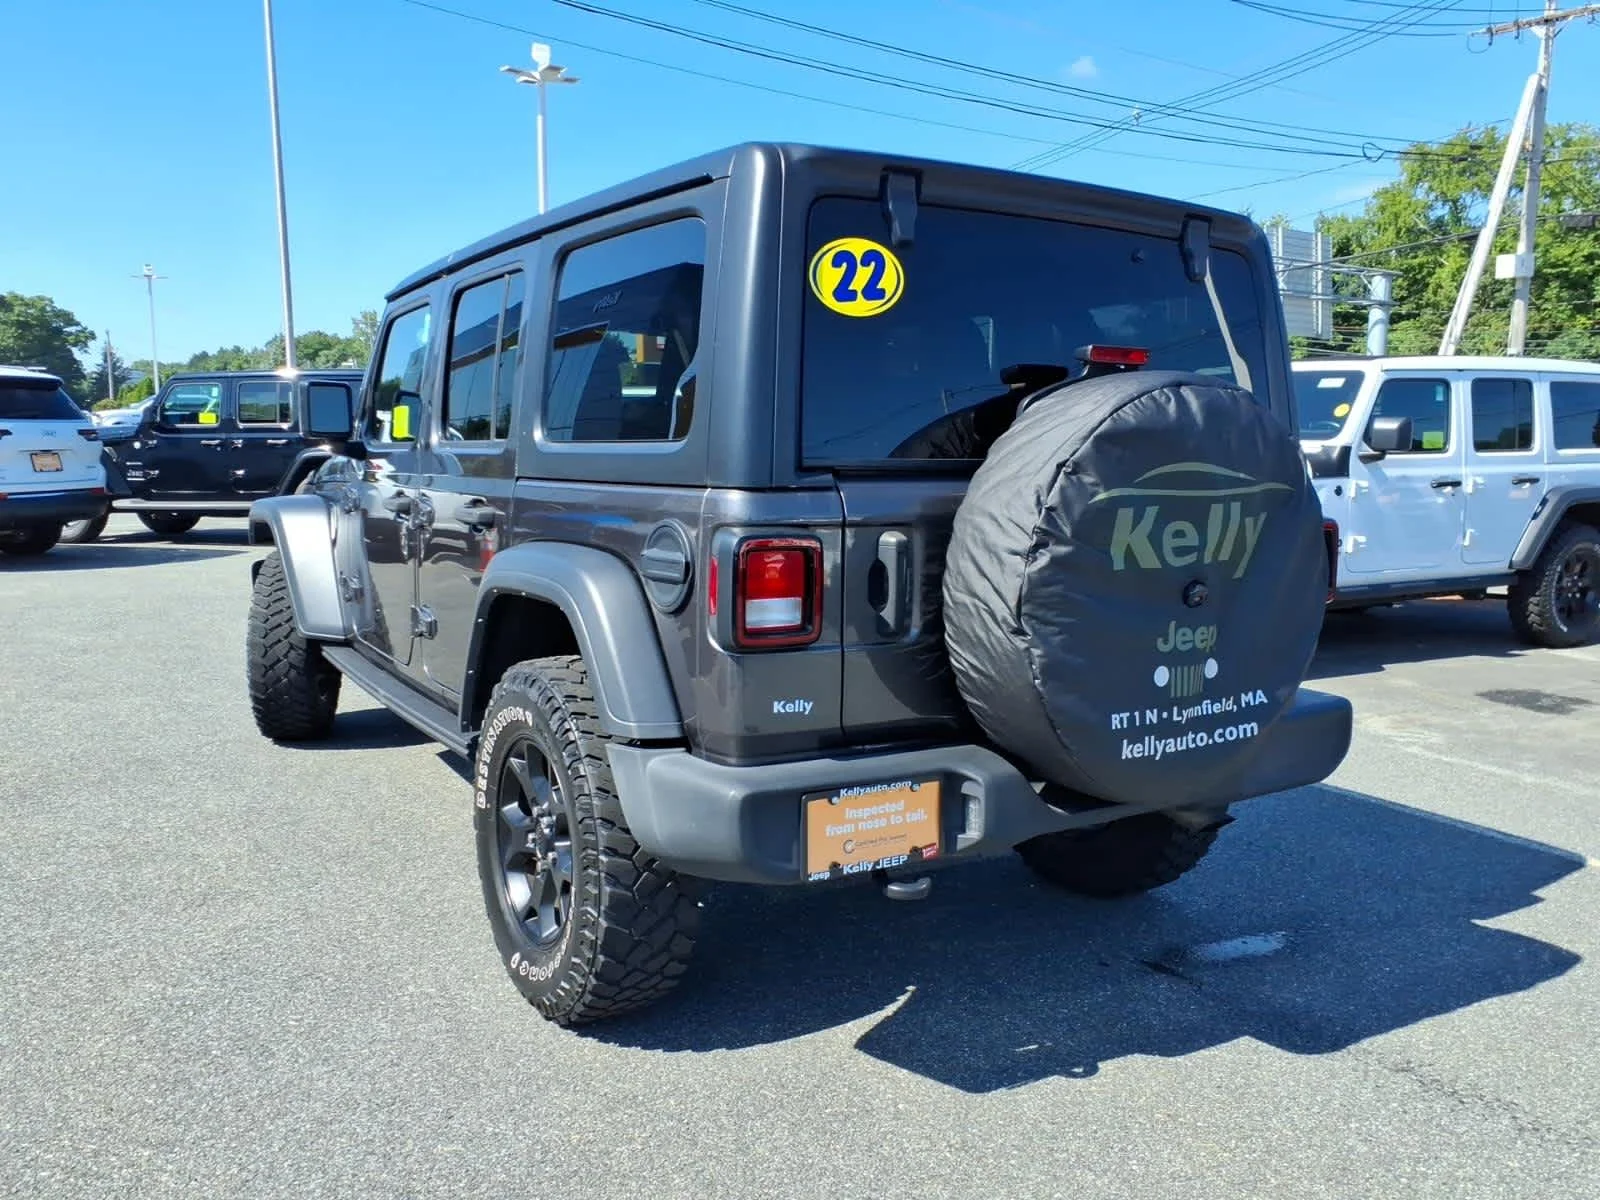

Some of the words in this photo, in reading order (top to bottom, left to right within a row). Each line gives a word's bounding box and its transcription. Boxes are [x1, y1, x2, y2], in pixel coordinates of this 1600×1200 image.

[832, 250, 886, 302] 22
[1110, 502, 1267, 579] Kelly
[1156, 620, 1217, 653] Jeep
[773, 699, 813, 715] Kelly
[1111, 711, 1130, 730] RT
[1134, 709, 1141, 727] 1
[1145, 707, 1158, 726] N
[1172, 696, 1238, 725] Lynnfield,
[1240, 689, 1268, 707] MA
[1121, 721, 1259, 760] kellyauto.com
[476, 706, 525, 809] DESTINATION
[840, 780, 912, 798] Kellyauto.com
[846, 801, 905, 819] Inspected
[826, 824, 855, 836] from
[859, 819, 888, 831] nose
[890, 814, 903, 826] to
[808, 871, 830, 881] Jeep
[843, 862, 874, 875] Kelly
[875, 856, 908, 869] JEEP
